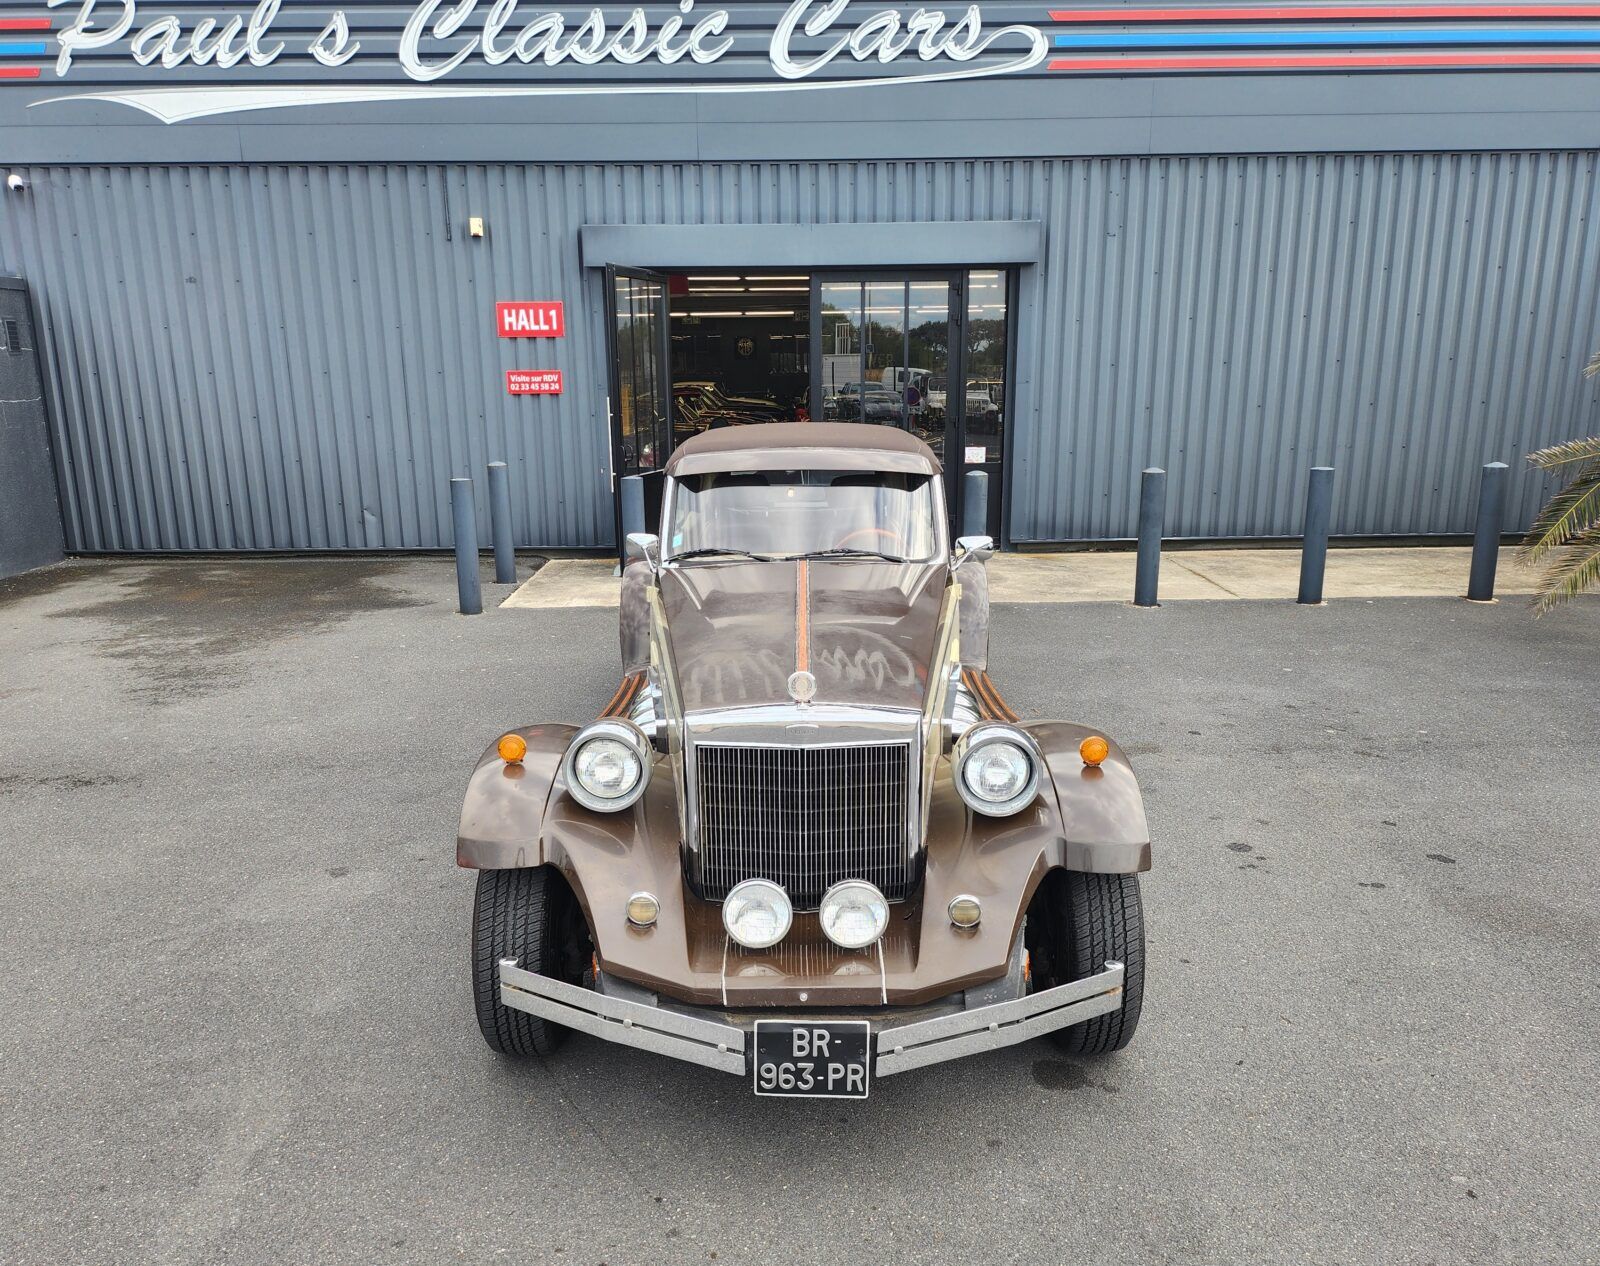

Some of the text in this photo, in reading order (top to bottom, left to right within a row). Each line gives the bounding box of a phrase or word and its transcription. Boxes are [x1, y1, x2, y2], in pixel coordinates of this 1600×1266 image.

[399, 0, 735, 81] Classic
[769, 0, 1010, 79] Cars
[510, 374, 530, 382] Visite
[543, 374, 558, 382] RDV
[792, 1028, 842, 1058] BR-
[759, 1062, 865, 1092] 963-PR
